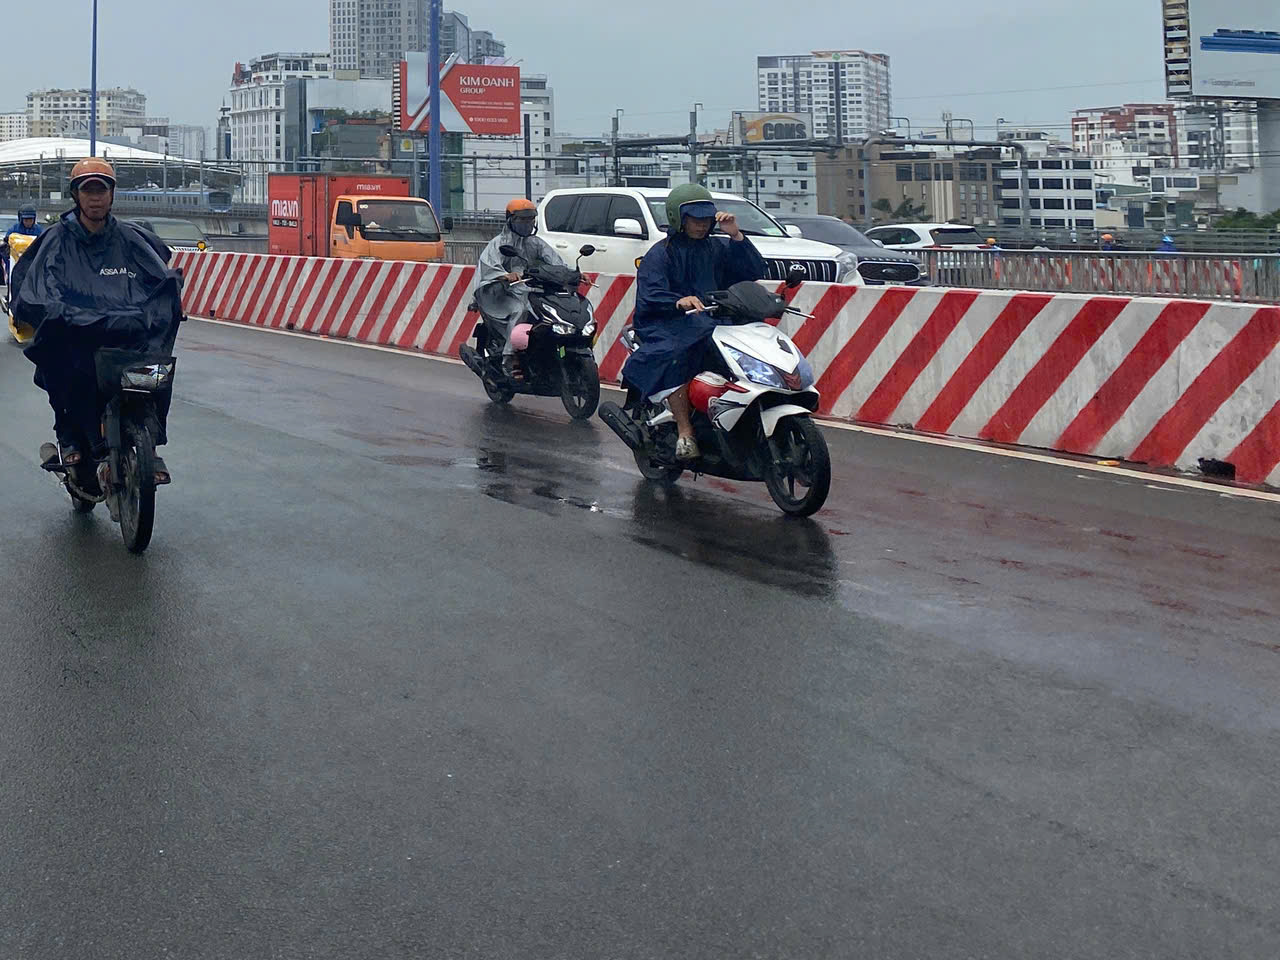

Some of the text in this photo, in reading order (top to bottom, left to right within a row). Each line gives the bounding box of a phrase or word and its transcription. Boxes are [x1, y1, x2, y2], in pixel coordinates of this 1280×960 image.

[459, 76, 515, 88] KIM OANH
[72, 120, 95, 131] PN
[99, 268, 119, 276] ASSA
